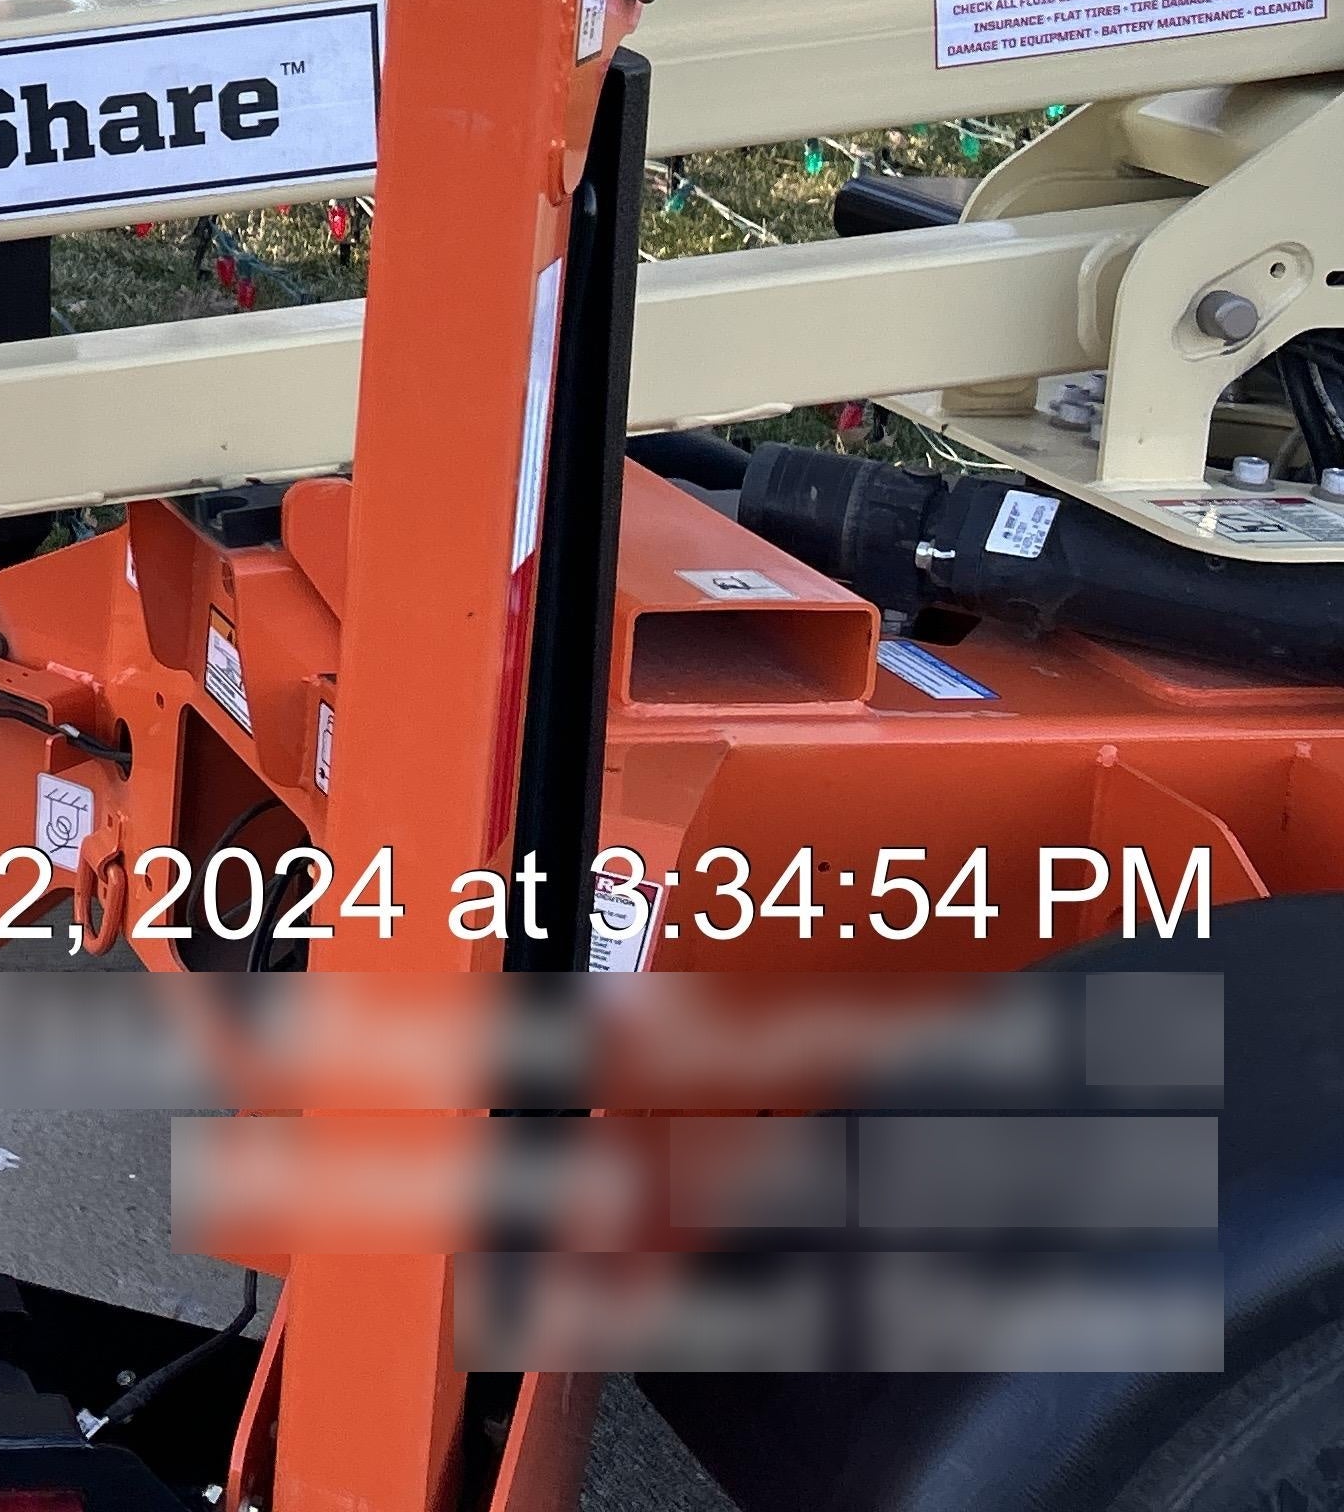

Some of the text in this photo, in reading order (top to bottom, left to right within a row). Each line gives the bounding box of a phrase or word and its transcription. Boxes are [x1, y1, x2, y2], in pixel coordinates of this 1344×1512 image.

[953, 0, 993, 16] CHECK
[974, 15, 1044, 33] INSURANCE
[1053, 9, 1082, 22] FLAT
[1085, 4, 1121, 18] TIRES
[1130, 0, 1158, 13] TIRE
[947, 0, 1313, 57] DAMAGE TO EQUIPMENT BATTERY MAINTENANCE CLEANING
